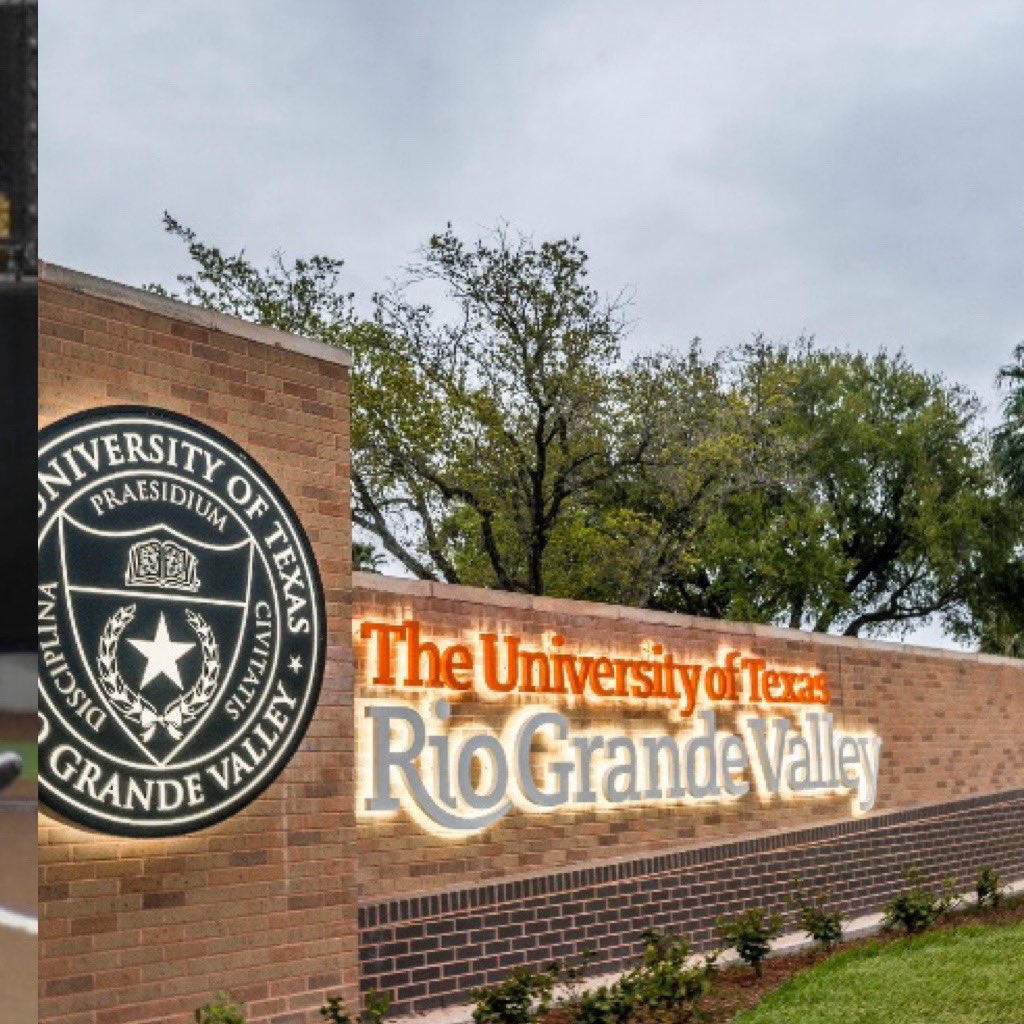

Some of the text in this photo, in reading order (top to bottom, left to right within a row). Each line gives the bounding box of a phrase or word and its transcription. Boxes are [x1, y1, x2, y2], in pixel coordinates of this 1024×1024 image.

[90, 480, 227, 532] PRAESIDIUM
[228, 476, 268, 517] OF
[264, 521, 310, 635] TEXAS
[38, 581, 107, 732] DISCIPLINA
[225, 602, 272, 720] CIVITATIS
[361, 620, 830, 717] The University of Texas
[49, 684, 298, 811] GRANDE VALLEY
[364, 700, 882, 830] Rio Grande Valley
